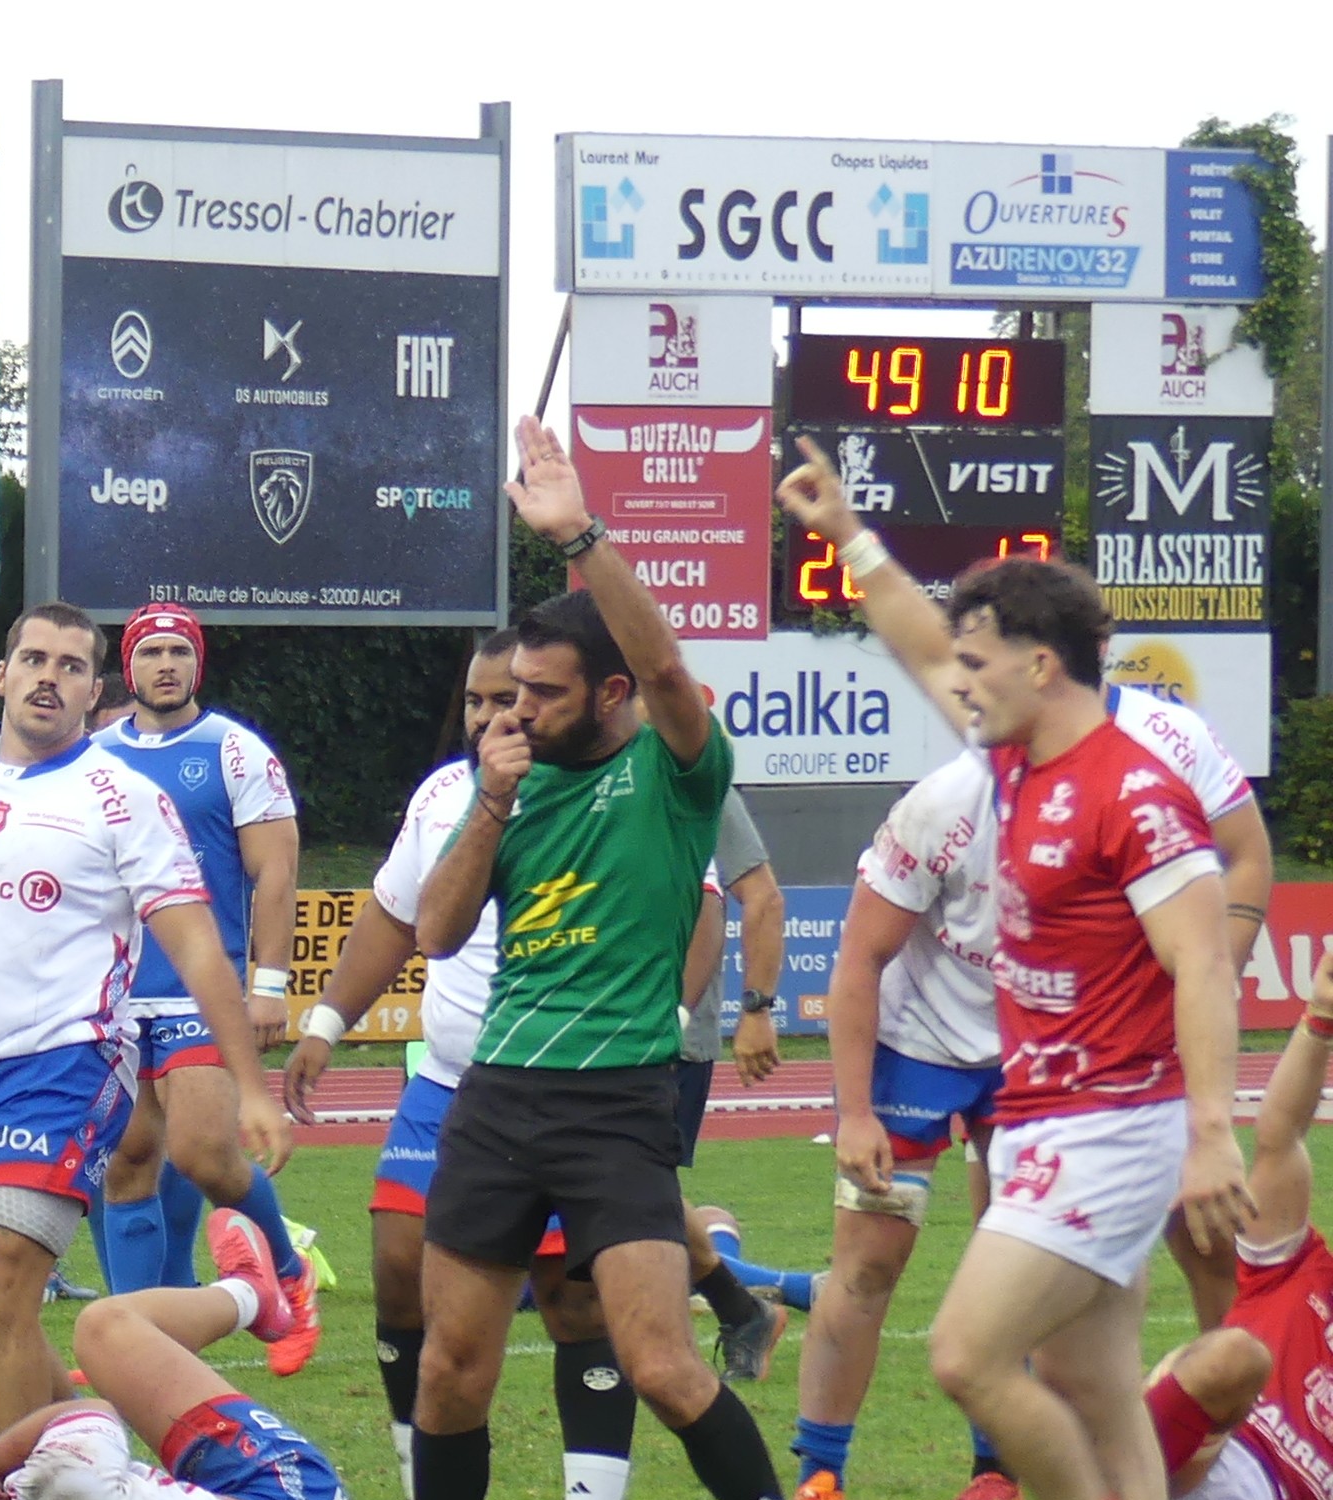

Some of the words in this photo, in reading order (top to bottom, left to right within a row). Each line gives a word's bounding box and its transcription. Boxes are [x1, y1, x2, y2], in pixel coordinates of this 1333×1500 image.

[580, 149, 630, 166] Laurent
[634, 150, 660, 166] Mur
[831, 153, 875, 172] Chapes
[879, 155, 929, 173] Liquides
[175, 188, 293, 234] Tressol
[314, 196, 455, 242] Chabrier
[677, 187, 834, 263] SGCC
[954, 246, 1128, 274] AZURENOV32
[396, 333, 455, 400] FIAT
[649, 372, 700, 391] AUCH
[847, 346, 923, 416] 49
[956, 349, 1012, 418] 10
[1160, 379, 1207, 399] AUCH
[235, 388, 251, 406] DS
[253, 389, 329, 407] AUTOMOBILES
[630, 423, 713, 453] BUFFALO
[90, 467, 169, 514] Jeep
[948, 462, 1055, 495] VISIT
[1126, 441, 1235, 522] M
[604, 530, 630, 545] ONE
[632, 530, 650, 544] DU
[652, 530, 697, 545] GRAND
[699, 530, 745, 545] CHENE
[635, 560, 707, 588] AUCH
[1095, 533, 1265, 586] BRASSERIE
[187, 585, 226, 603] Route
[229, 585, 249, 604] de
[251, 586, 310, 605] Toulouse
[319, 587, 359, 606] 32000
[360, 588, 402, 606] AUCH
[691, 604, 722, 629] 00
[728, 604, 758, 629] 58
[723, 670, 890, 738] dalkia
[765, 752, 838, 776] GROUPE
